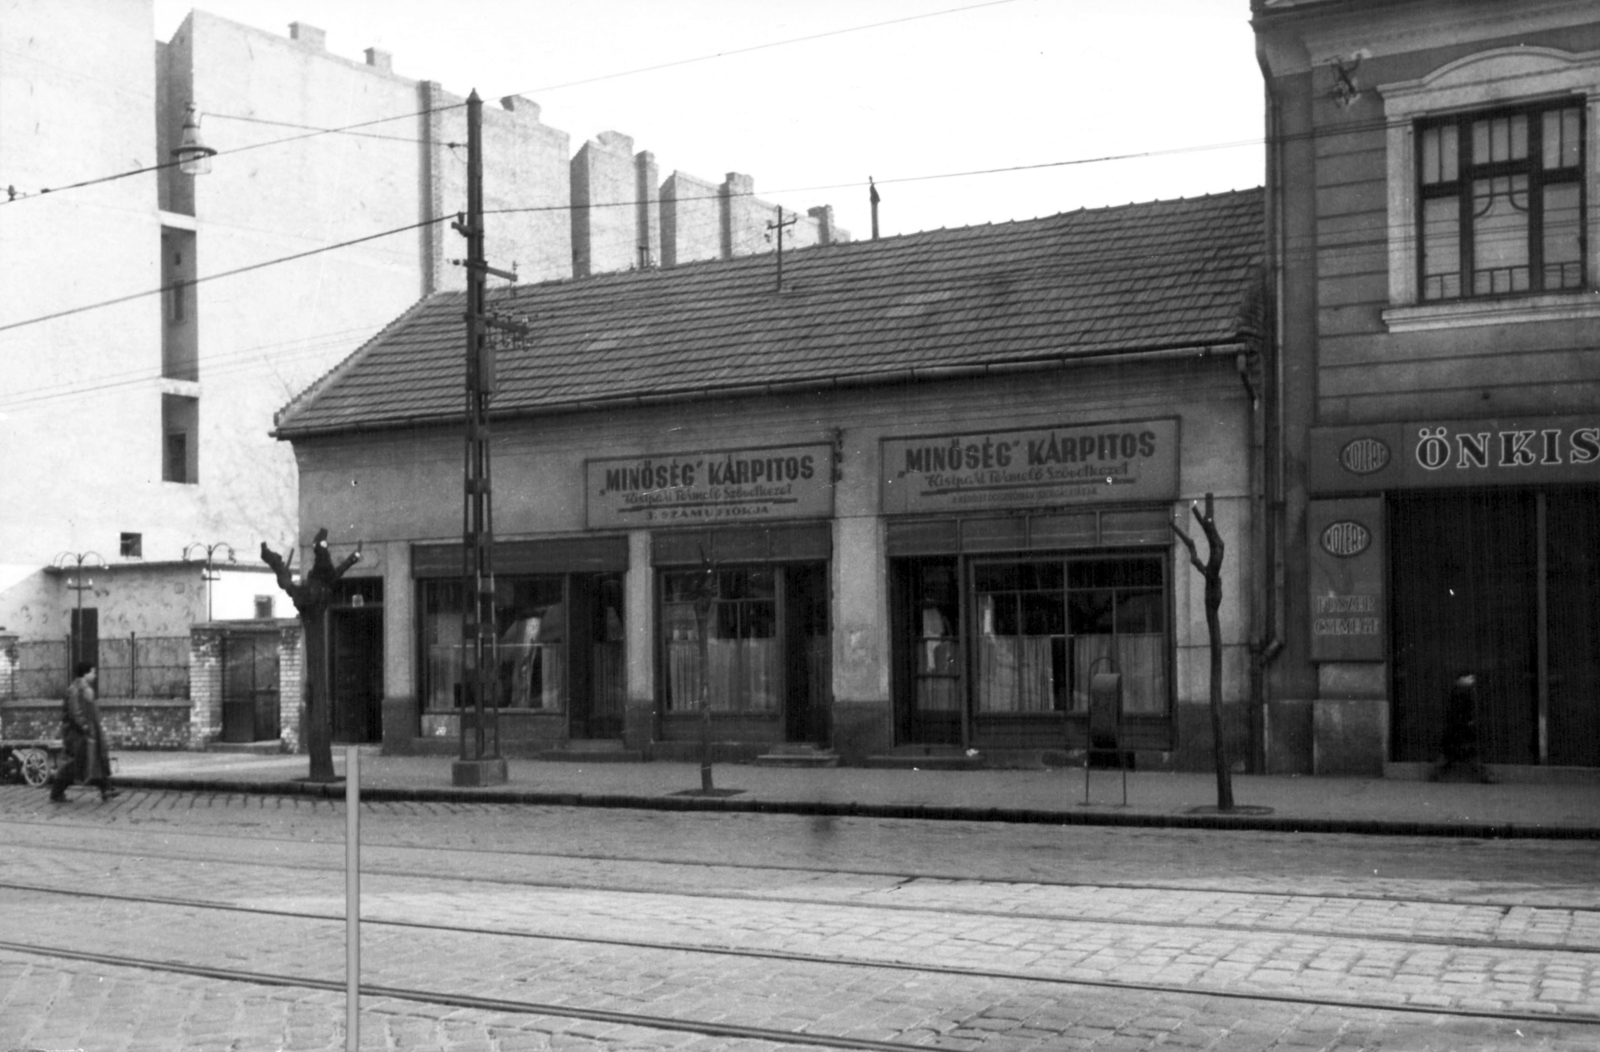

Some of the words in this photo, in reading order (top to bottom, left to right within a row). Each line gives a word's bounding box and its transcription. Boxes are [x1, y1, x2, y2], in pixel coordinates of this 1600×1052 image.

[1028, 431, 1156, 466] KÁRPITOS
[1416, 427, 1600, 470] ÖNKIS
[708, 453, 814, 485] KÁRPITOS
[1047, 461, 1129, 478] Szövetkezet
